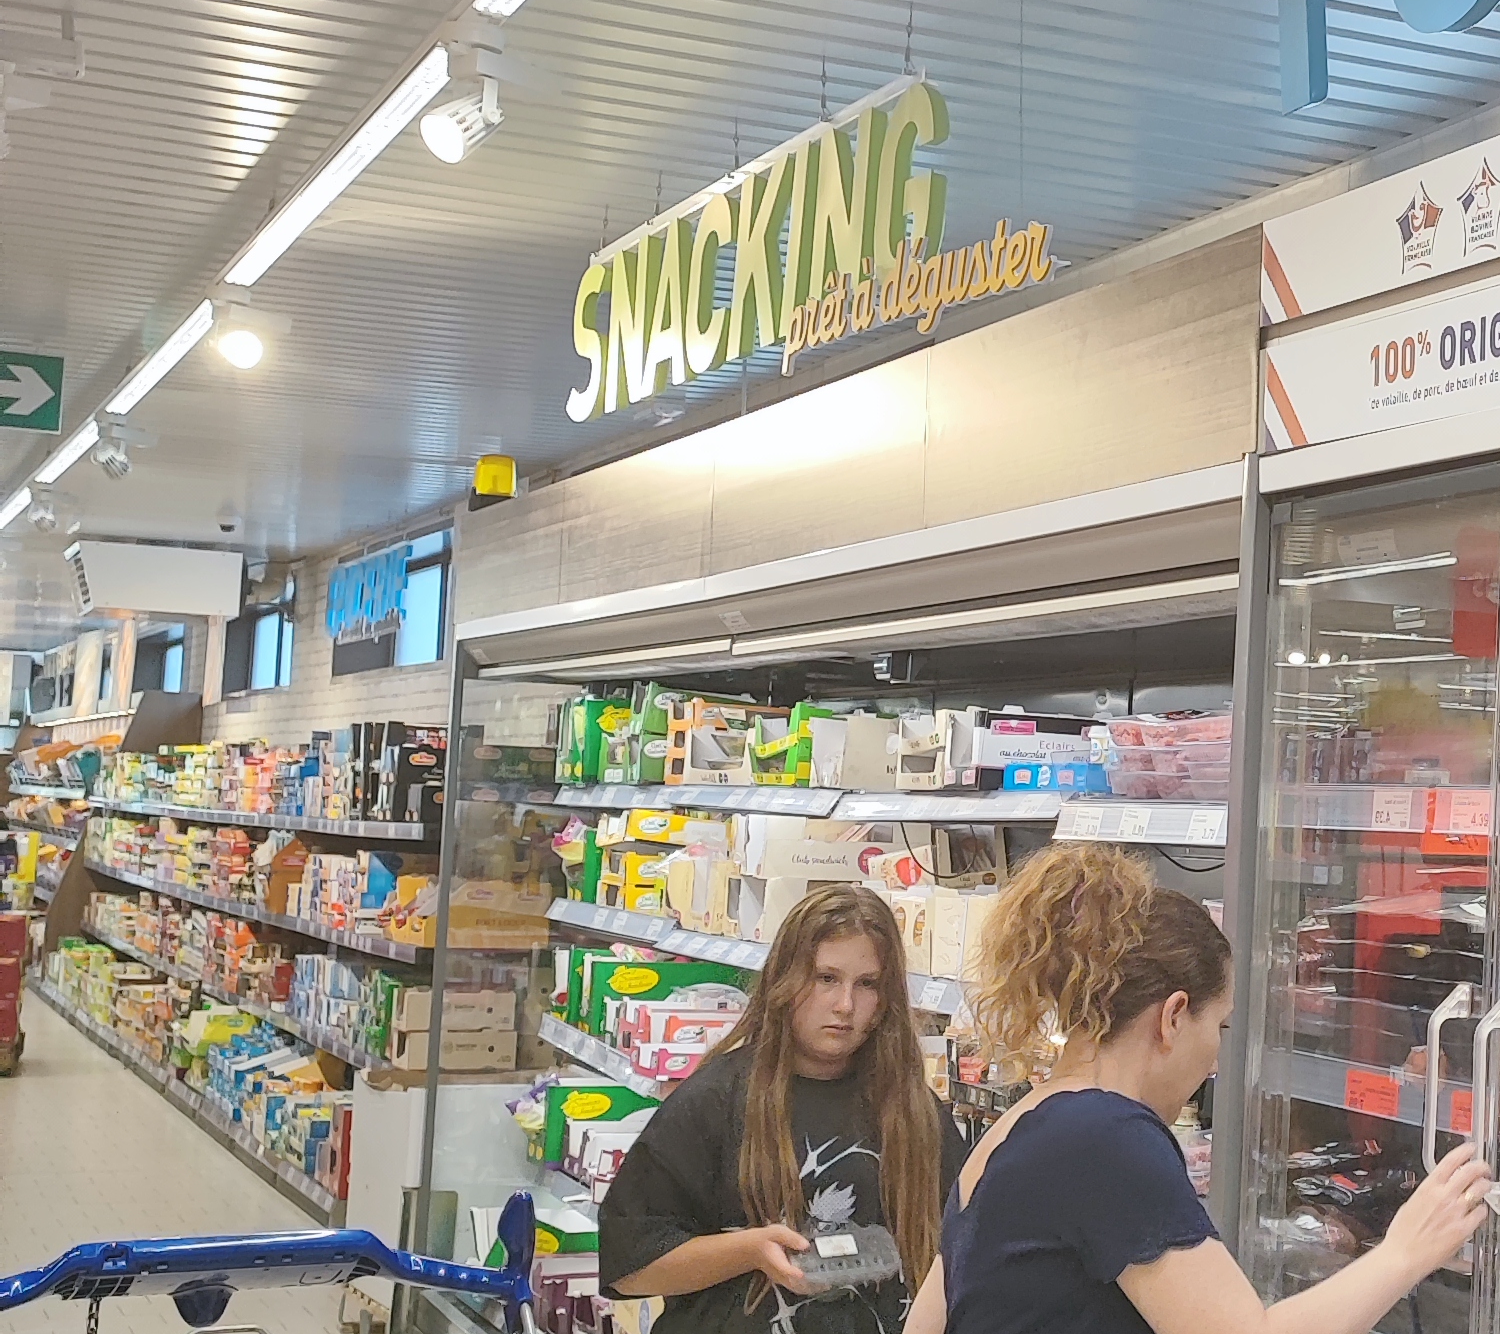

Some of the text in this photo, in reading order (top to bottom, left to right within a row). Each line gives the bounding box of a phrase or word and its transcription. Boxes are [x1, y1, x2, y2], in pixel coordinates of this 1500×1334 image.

[564, 81, 950, 423] SNACKING
[781, 218, 1055, 378] prêt à déguster
[1370, 330, 1432, 387] 100%
[1412, 386, 1422, 401] de
[1445, 379, 1454, 393] de
[1489, 369, 1499, 383] de
